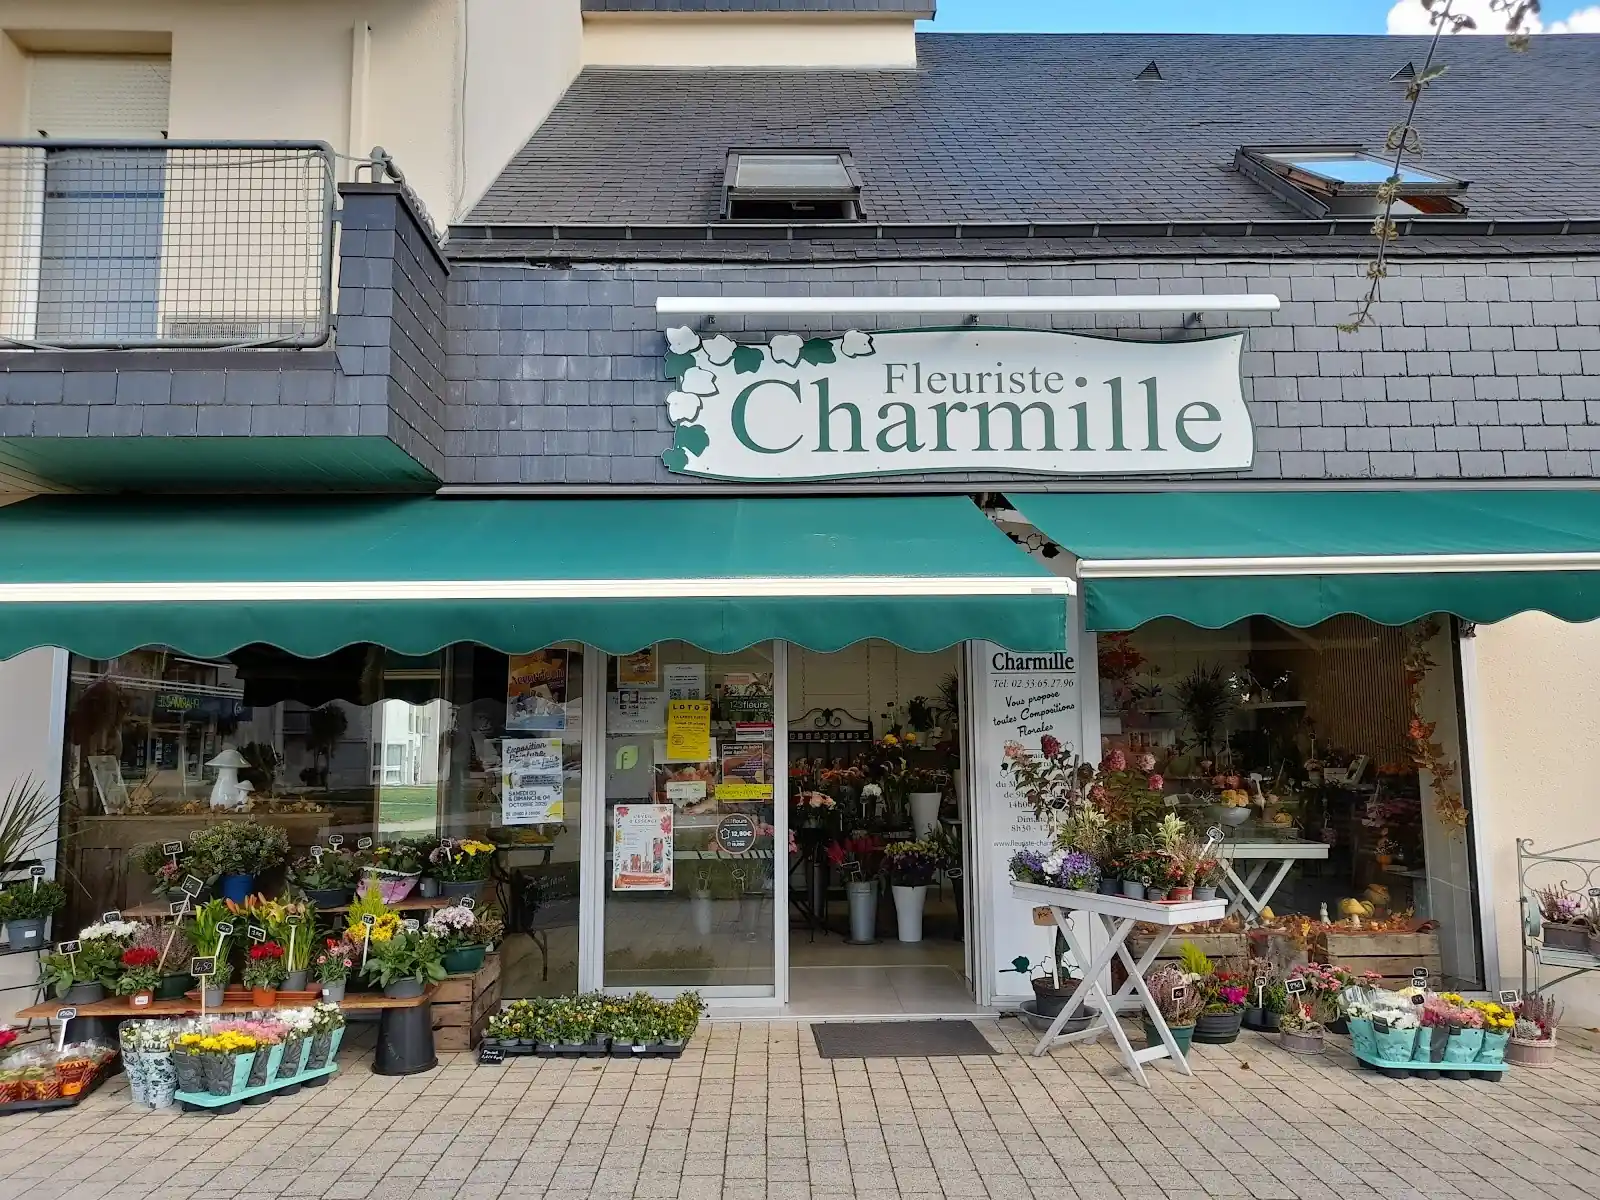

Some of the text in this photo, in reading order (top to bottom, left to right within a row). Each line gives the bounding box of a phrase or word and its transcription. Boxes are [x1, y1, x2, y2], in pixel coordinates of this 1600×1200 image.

[884, 362, 1065, 395] Fleuriste
[731, 376, 1223, 456] Charmille
[992, 652, 1075, 671] Charmille
[1011, 679, 1074, 688] 02.33.65.27.96
[1005, 691, 1060, 707] Vous propose
[993, 703, 1075, 726] toutes Compositions
[1017, 722, 1054, 737] Florales
[506, 742, 547, 755] Exposition
[1003, 791, 1014, 799] de
